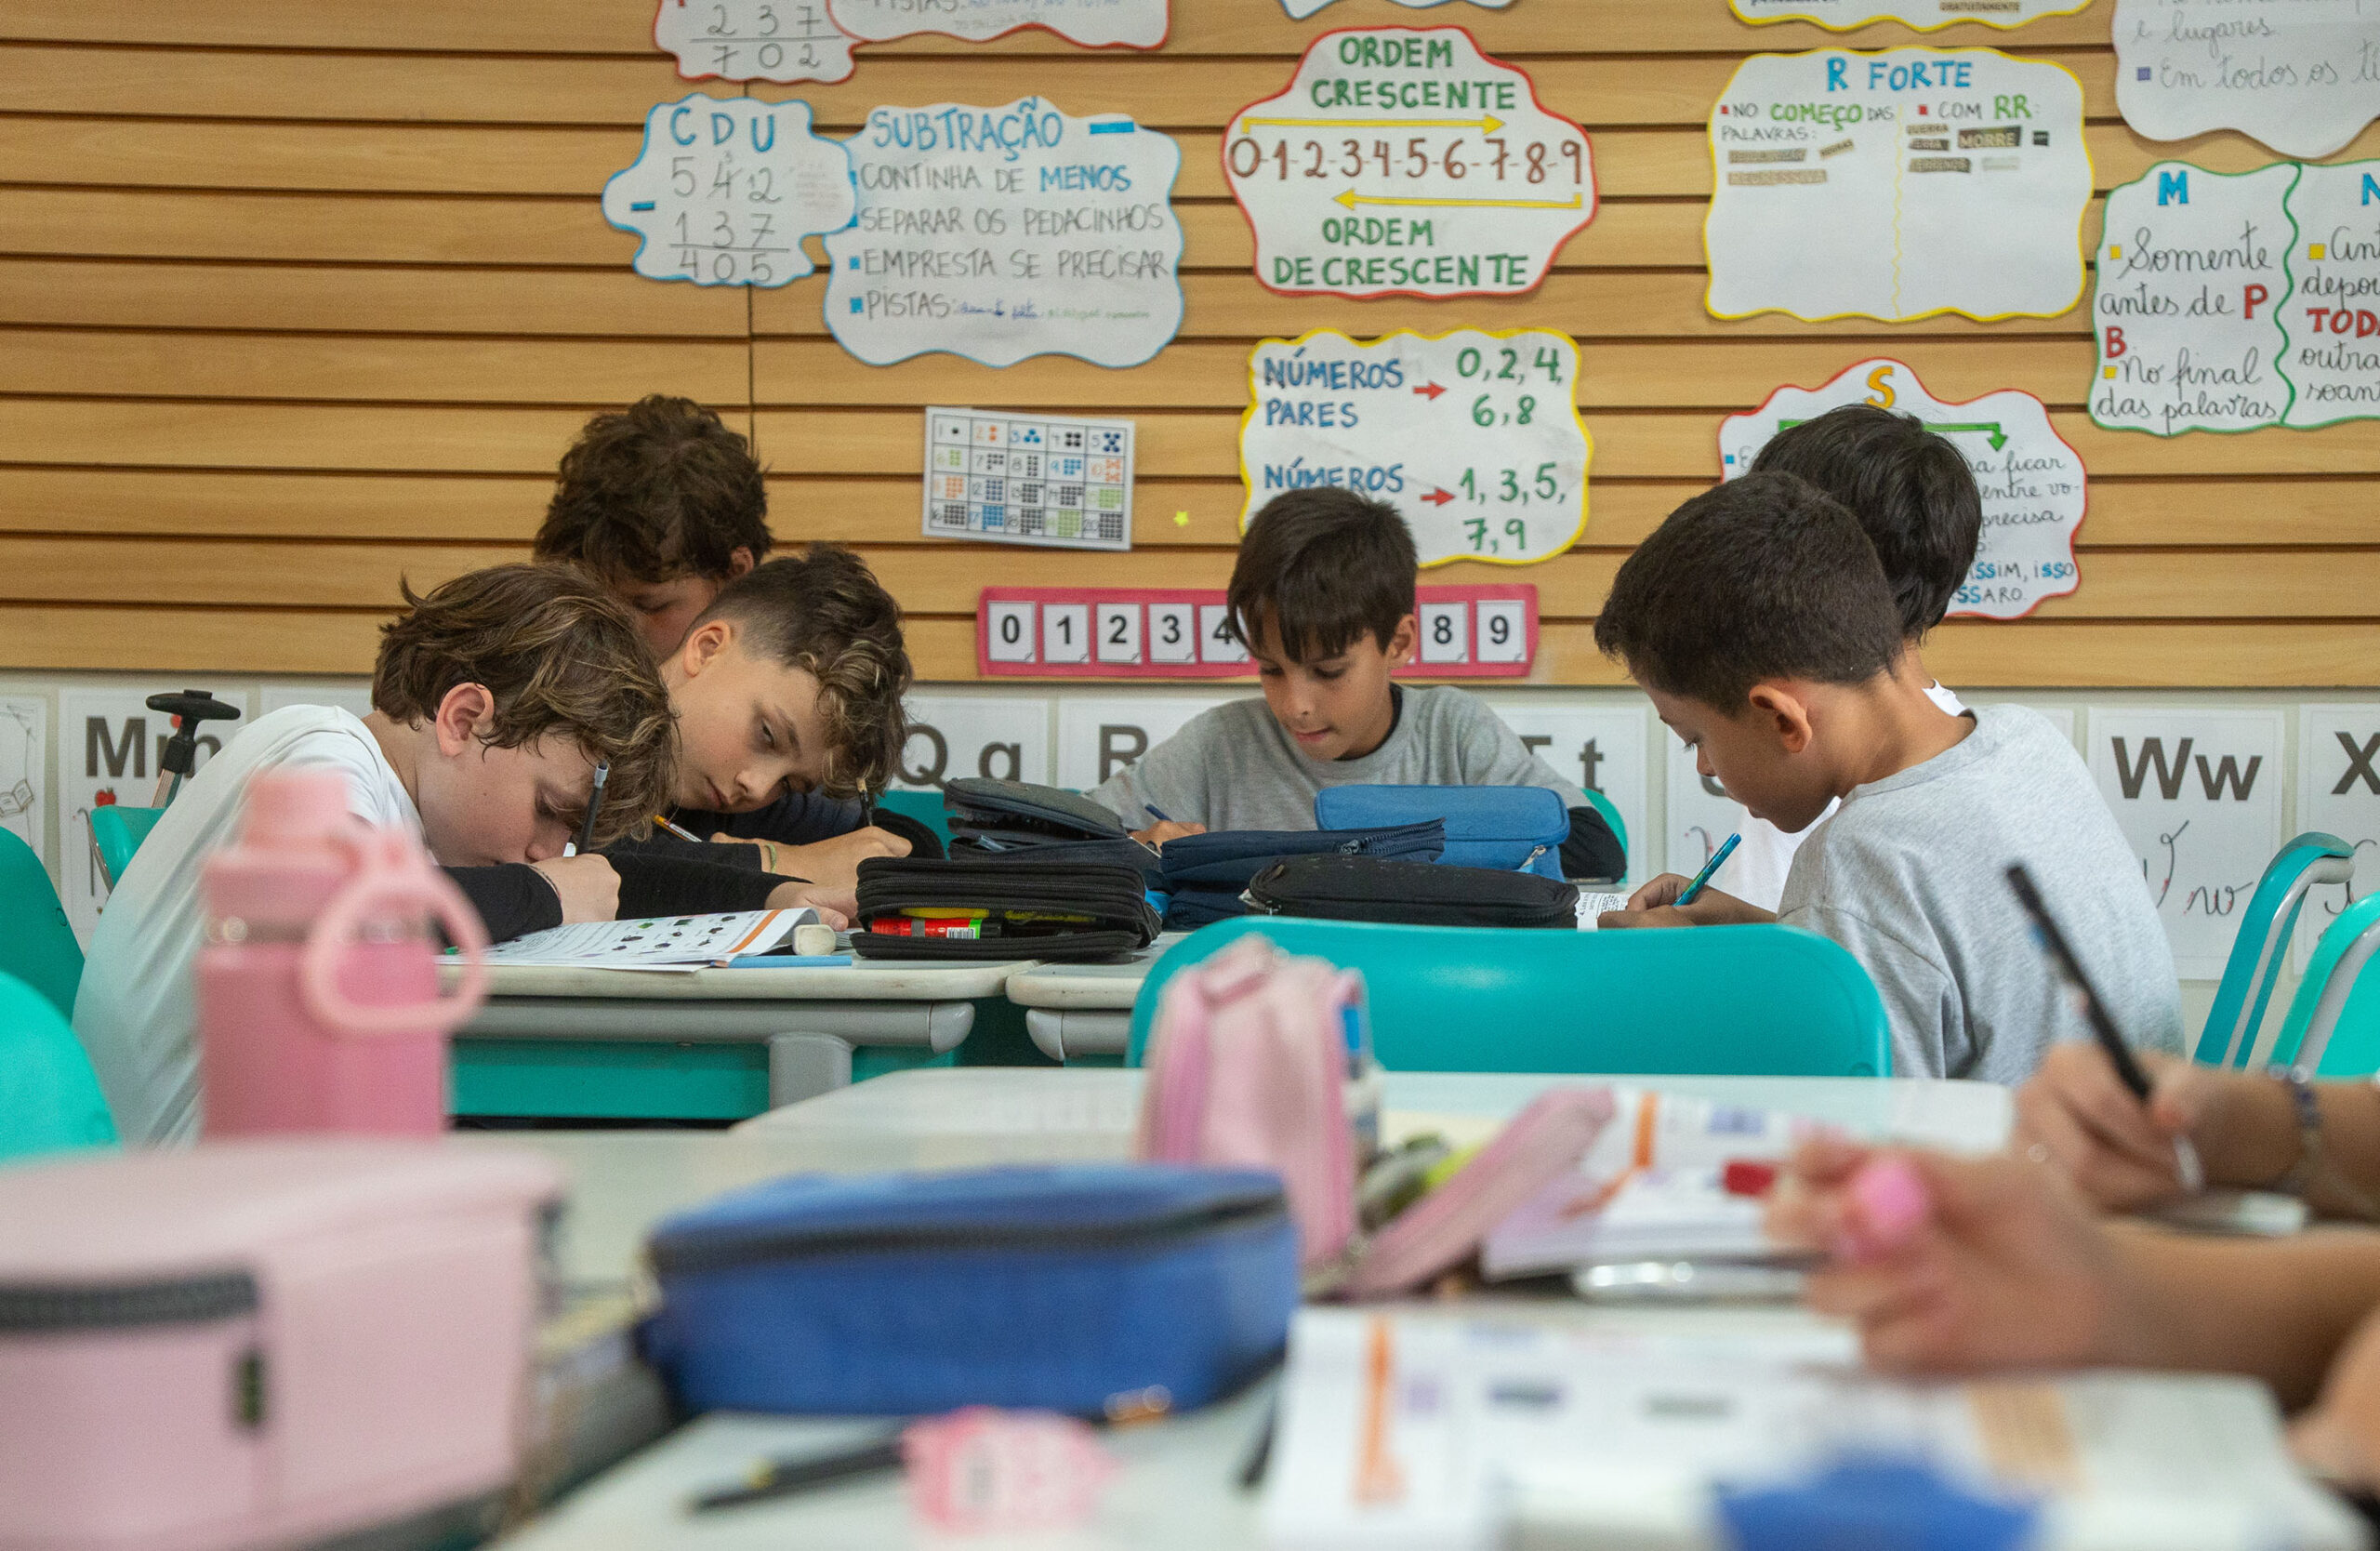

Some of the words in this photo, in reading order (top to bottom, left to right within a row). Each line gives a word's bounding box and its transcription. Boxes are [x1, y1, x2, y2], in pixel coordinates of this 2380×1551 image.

[707, 5, 736, 35] 2
[759, 5, 778, 36] 3
[796, 6, 823, 35] 7
[2164, 10, 2277, 58] lugares
[711, 46, 739, 73] 7
[758, 43, 783, 69] 0
[799, 43, 820, 68] 2
[1339, 35, 1453, 69] ORDEM
[1826, 57, 1848, 91] R
[1869, 60, 1973, 91] FORTE
[2215, 56, 2297, 88] todos
[2305, 60, 2338, 86] os
[1311, 79, 1516, 110] CRESCENTE
[1938, 100, 1982, 120] COM
[670, 107, 697, 146] C
[710, 113, 734, 146] D
[751, 113, 774, 152] U
[870, 96, 1064, 162] SUBTRAÇÃO
[1732, 103, 1758, 118] NO
[1770, 102, 1863, 131] COMEÇO
[1868, 105, 1895, 122] DAS
[671, 156, 696, 198] 5
[859, 161, 982, 193] CONTINHA
[995, 166, 1025, 194] DE
[1039, 163, 1132, 192] MENOS
[2157, 170, 2188, 206] M
[2361, 172, 2380, 206] N
[712, 211, 735, 248] 3
[751, 213, 775, 247] 7
[860, 205, 964, 232] SEPARAR
[974, 206, 1007, 234] OS
[1023, 202, 1164, 236] PEDACINHOS
[1322, 218, 1435, 246] ORDEM
[679, 249, 698, 279] 4
[713, 253, 735, 281] 0
[751, 253, 774, 283] 5
[863, 247, 998, 279] EMPRESTA
[1010, 247, 1042, 279] SE
[1057, 244, 1170, 280] PRECISAR
[2116, 220, 2274, 280] Somente
[1274, 253, 1529, 286] DECRESCENTE
[2099, 281, 2180, 317] antes
[2185, 284, 2235, 317] de
[2243, 284, 2269, 320] P
[2307, 307, 2380, 338] TOD
[2106, 325, 2127, 359] B
[1263, 347, 1405, 391] NÚMEROS
[2167, 346, 2264, 402] final
[1865, 366, 1896, 409] S
[2306, 380, 2380, 403] soan
[1265, 398, 1359, 429] PARES
[2096, 385, 2151, 419] das
[2161, 390, 2277, 436] palavras
[1264, 457, 1405, 493] NÚMEROS
[2002, 449, 2067, 484] ficar
[1981, 507, 2064, 538] precisa
[1001, 614, 1020, 643] 0
[1056, 615, 1070, 644] 1
[1108, 614, 1128, 643] 2
[1162, 614, 1180, 643] 3
[1212, 616, 1231, 644] 4
[1434, 615, 1452, 644] 8
[1490, 615, 1509, 644] 9
[1099, 724, 1148, 786] R
[2110, 736, 2264, 802] Ww
[2331, 731, 2380, 795] X
